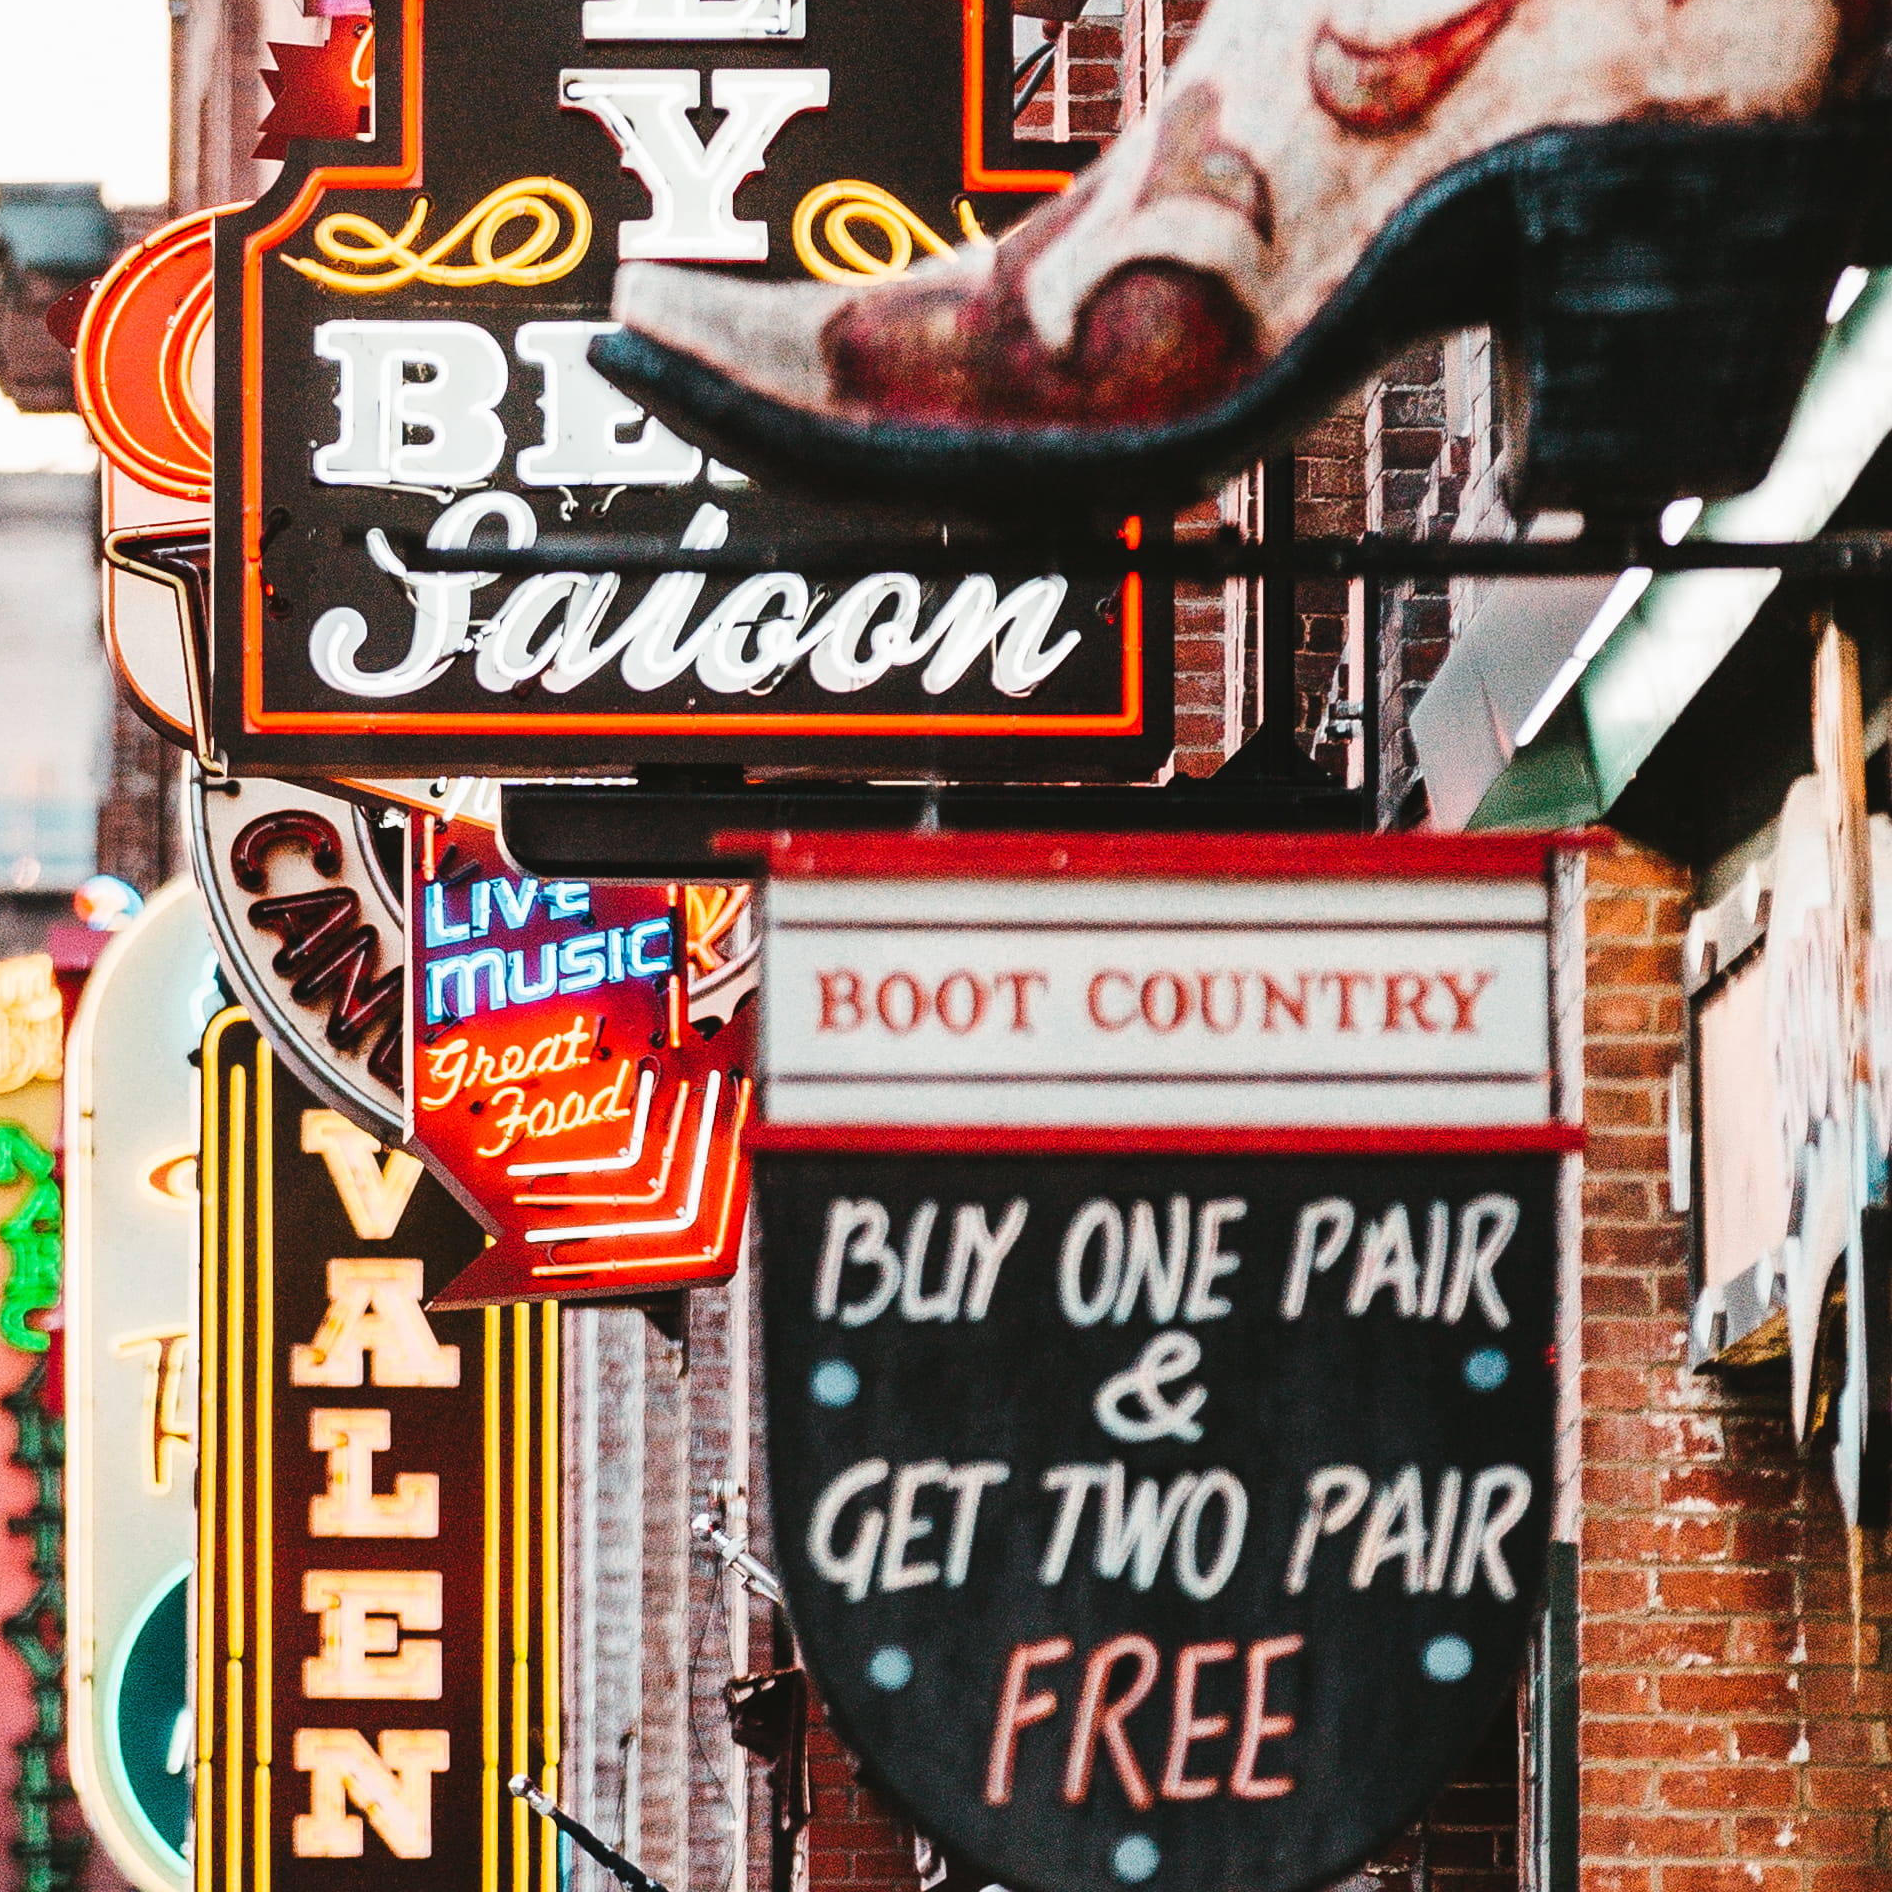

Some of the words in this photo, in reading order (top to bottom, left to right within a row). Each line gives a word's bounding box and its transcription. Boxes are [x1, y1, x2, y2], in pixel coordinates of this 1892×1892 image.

[312, 318, 750, 487] BE
[310, 490, 1082, 695] Saloon
[420, 1015, 591, 1112] Great
[814, 969, 1048, 1036] BOOT
[1086, 967, 1500, 1036] COUNTRY
[476, 1059, 632, 1158] Food
[818, 1196, 1029, 1327] BUY
[1058, 1194, 1248, 1327] ONE
[1281, 1194, 1520, 1330] PAIR
[1094, 1330, 1210, 1444] &
[806, 1458, 1009, 1604] GET
[1040, 1461, 1248, 1601] TWO
[1286, 1463, 1533, 1601] PAIR
[984, 1633, 1306, 1810] FREE
